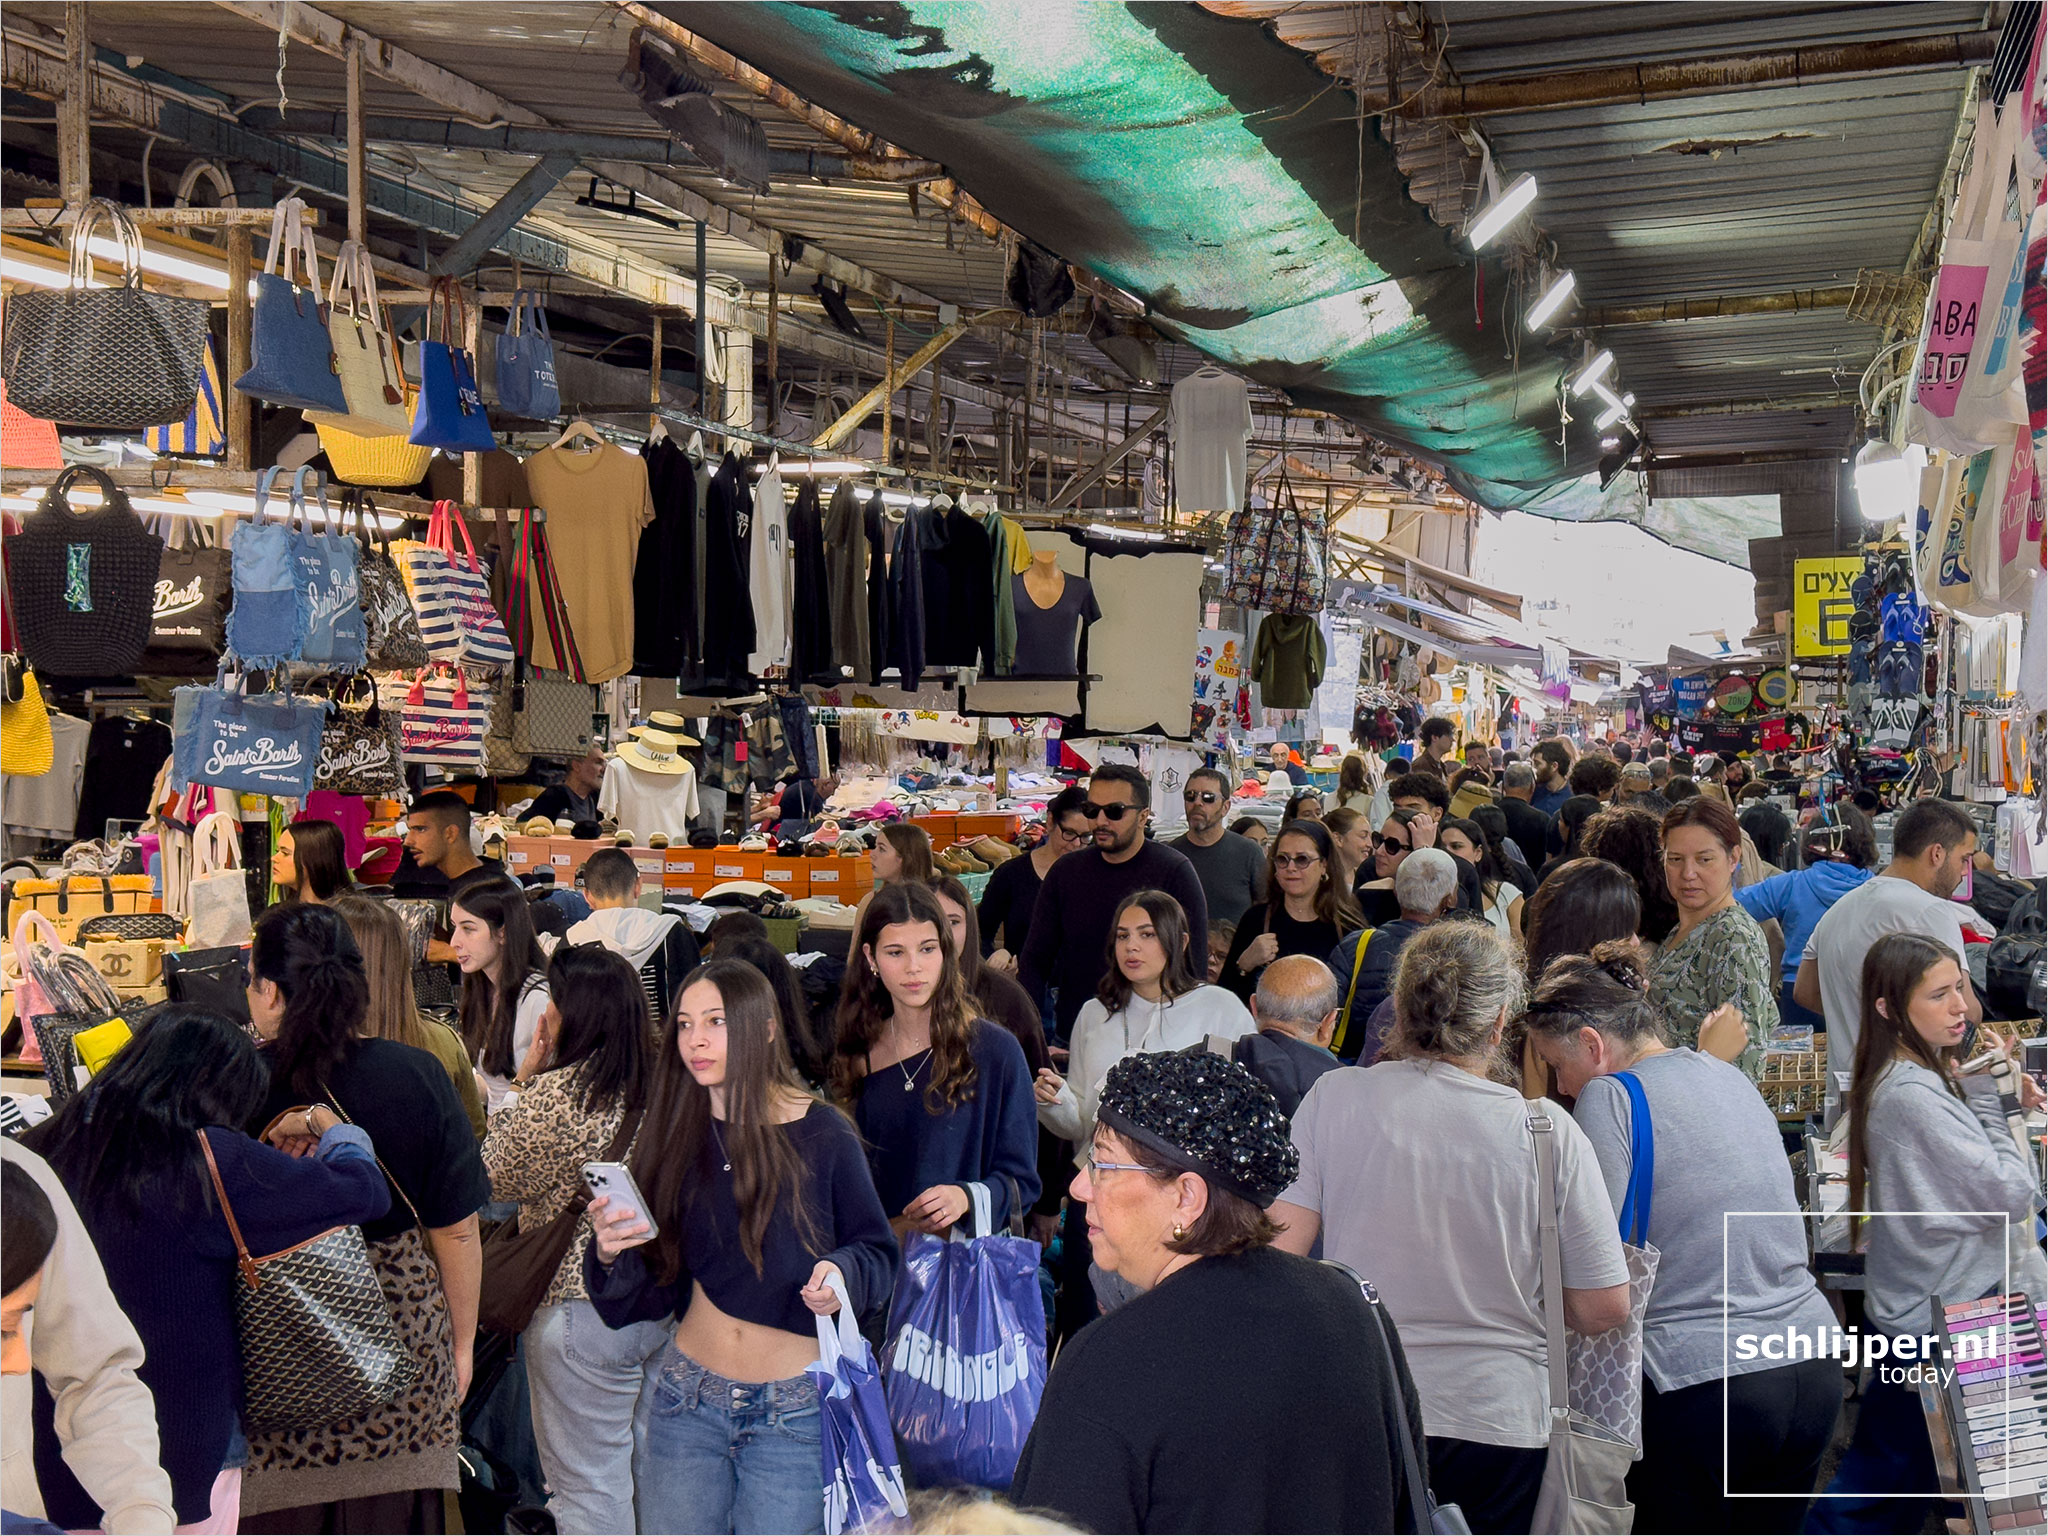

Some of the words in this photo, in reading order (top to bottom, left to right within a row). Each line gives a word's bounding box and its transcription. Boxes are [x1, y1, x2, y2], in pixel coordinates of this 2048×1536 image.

[153, 575, 204, 616] Barth
[1728, 696, 1747, 706] ZONE
[213, 719, 227, 729] The
[228, 721, 248, 732] place
[220, 729, 228, 737] to
[229, 730, 239, 738] be
[205, 740, 250, 775] Saint
[248, 737, 303, 771] Barth
[316, 746, 352, 780] Saint
[351, 738, 391, 772] Barth
[259, 772, 278, 781] Summer
